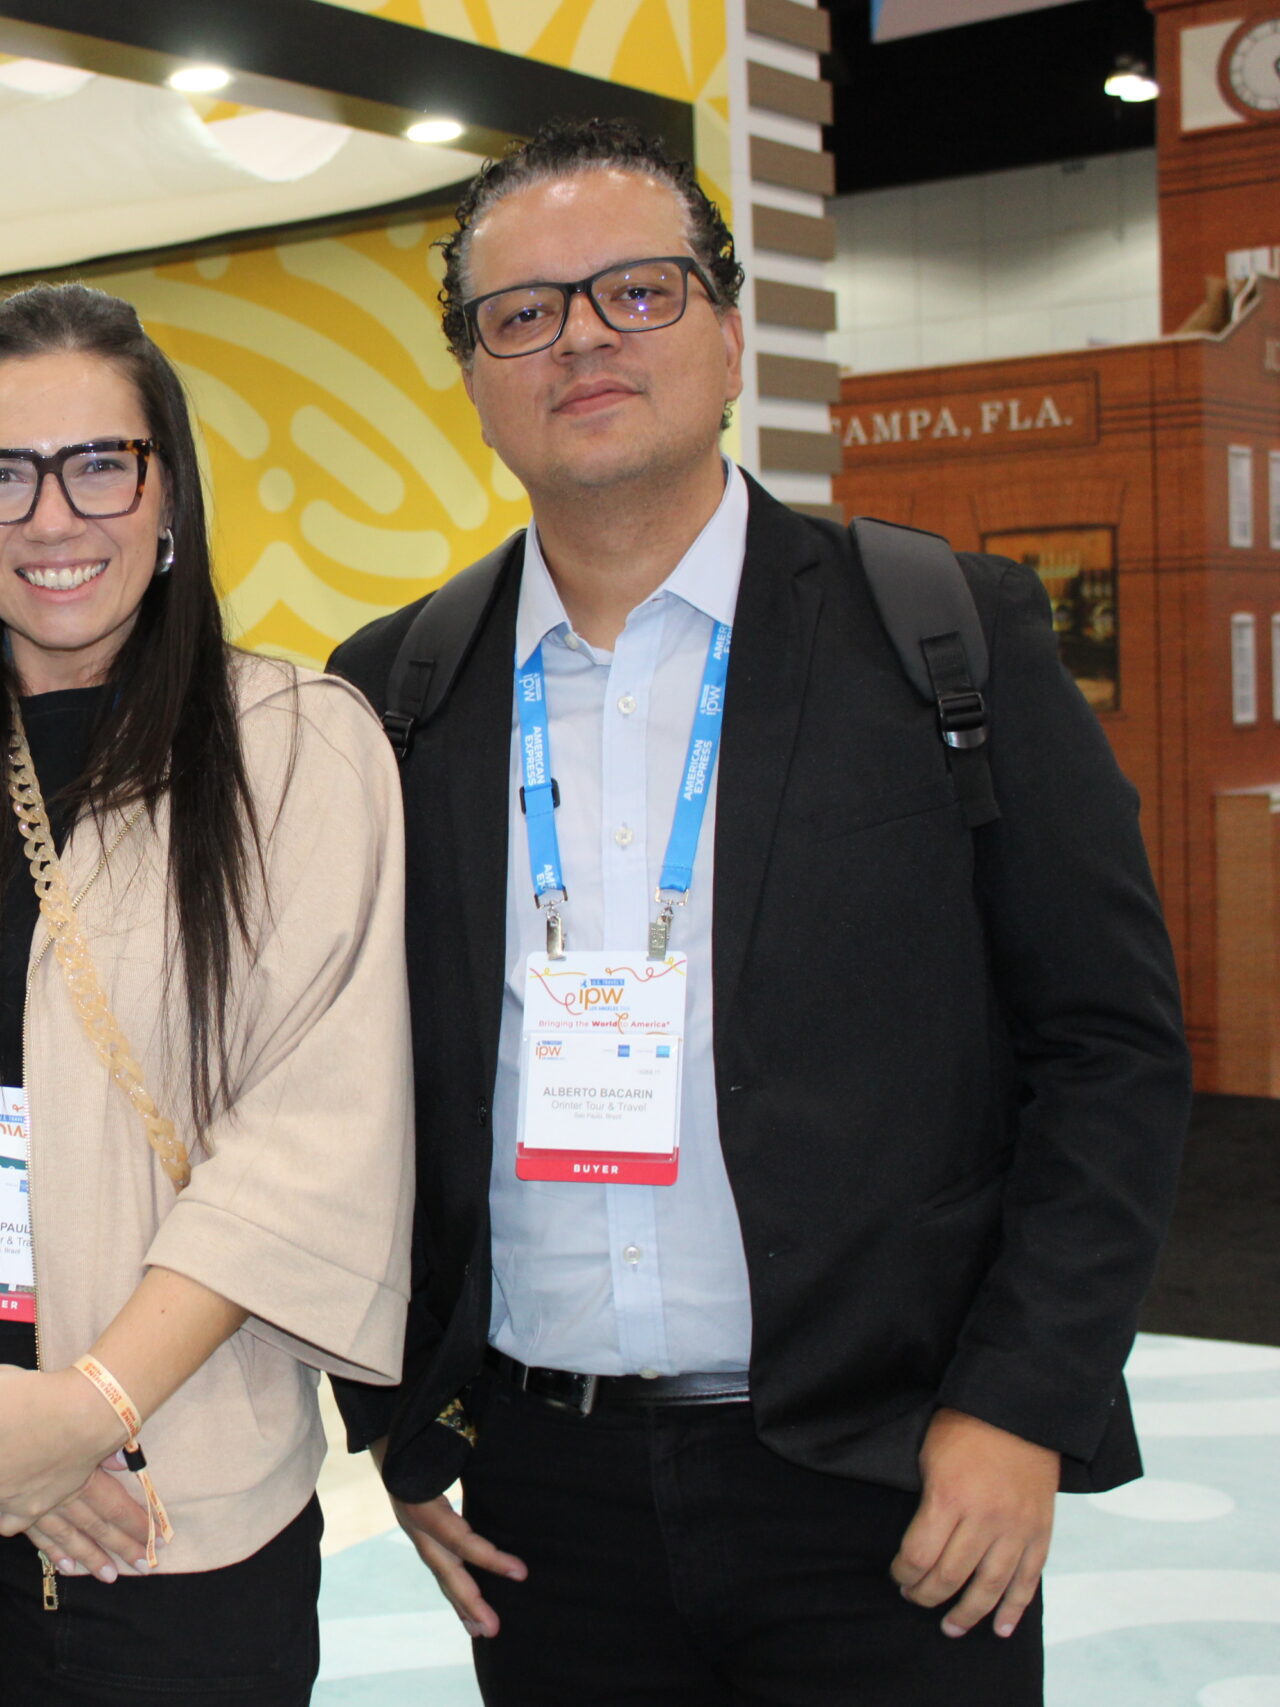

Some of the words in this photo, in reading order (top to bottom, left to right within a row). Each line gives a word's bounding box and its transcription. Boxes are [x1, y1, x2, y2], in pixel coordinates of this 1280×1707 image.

[979, 395, 1074, 435] FLA.
[519, 674, 535, 702] ipw
[706, 685, 723, 716] ipw
[524, 735, 537, 786] EXPRESS
[533, 725, 545, 784] AMERICAN
[694, 740, 712, 796] EXPRESS
[683, 739, 704, 801] AMERICAN
[579, 987, 624, 1011] ipw
[538, 1020, 573, 1029] Bringing
[536, 1045, 562, 1059] ipw
[543, 1087, 597, 1098] ALBERTO
[600, 1088, 653, 1099] BACARIN
[551, 1101, 582, 1110] Orinter
[586, 1101, 605, 1111] Tour
[608, 1102, 615, 1111] &
[619, 1102, 647, 1112] Travel
[573, 1164, 619, 1175] BUYER
[6, 1235, 13, 1245] &
[83, 1364, 117, 1405] SUNSHINE
